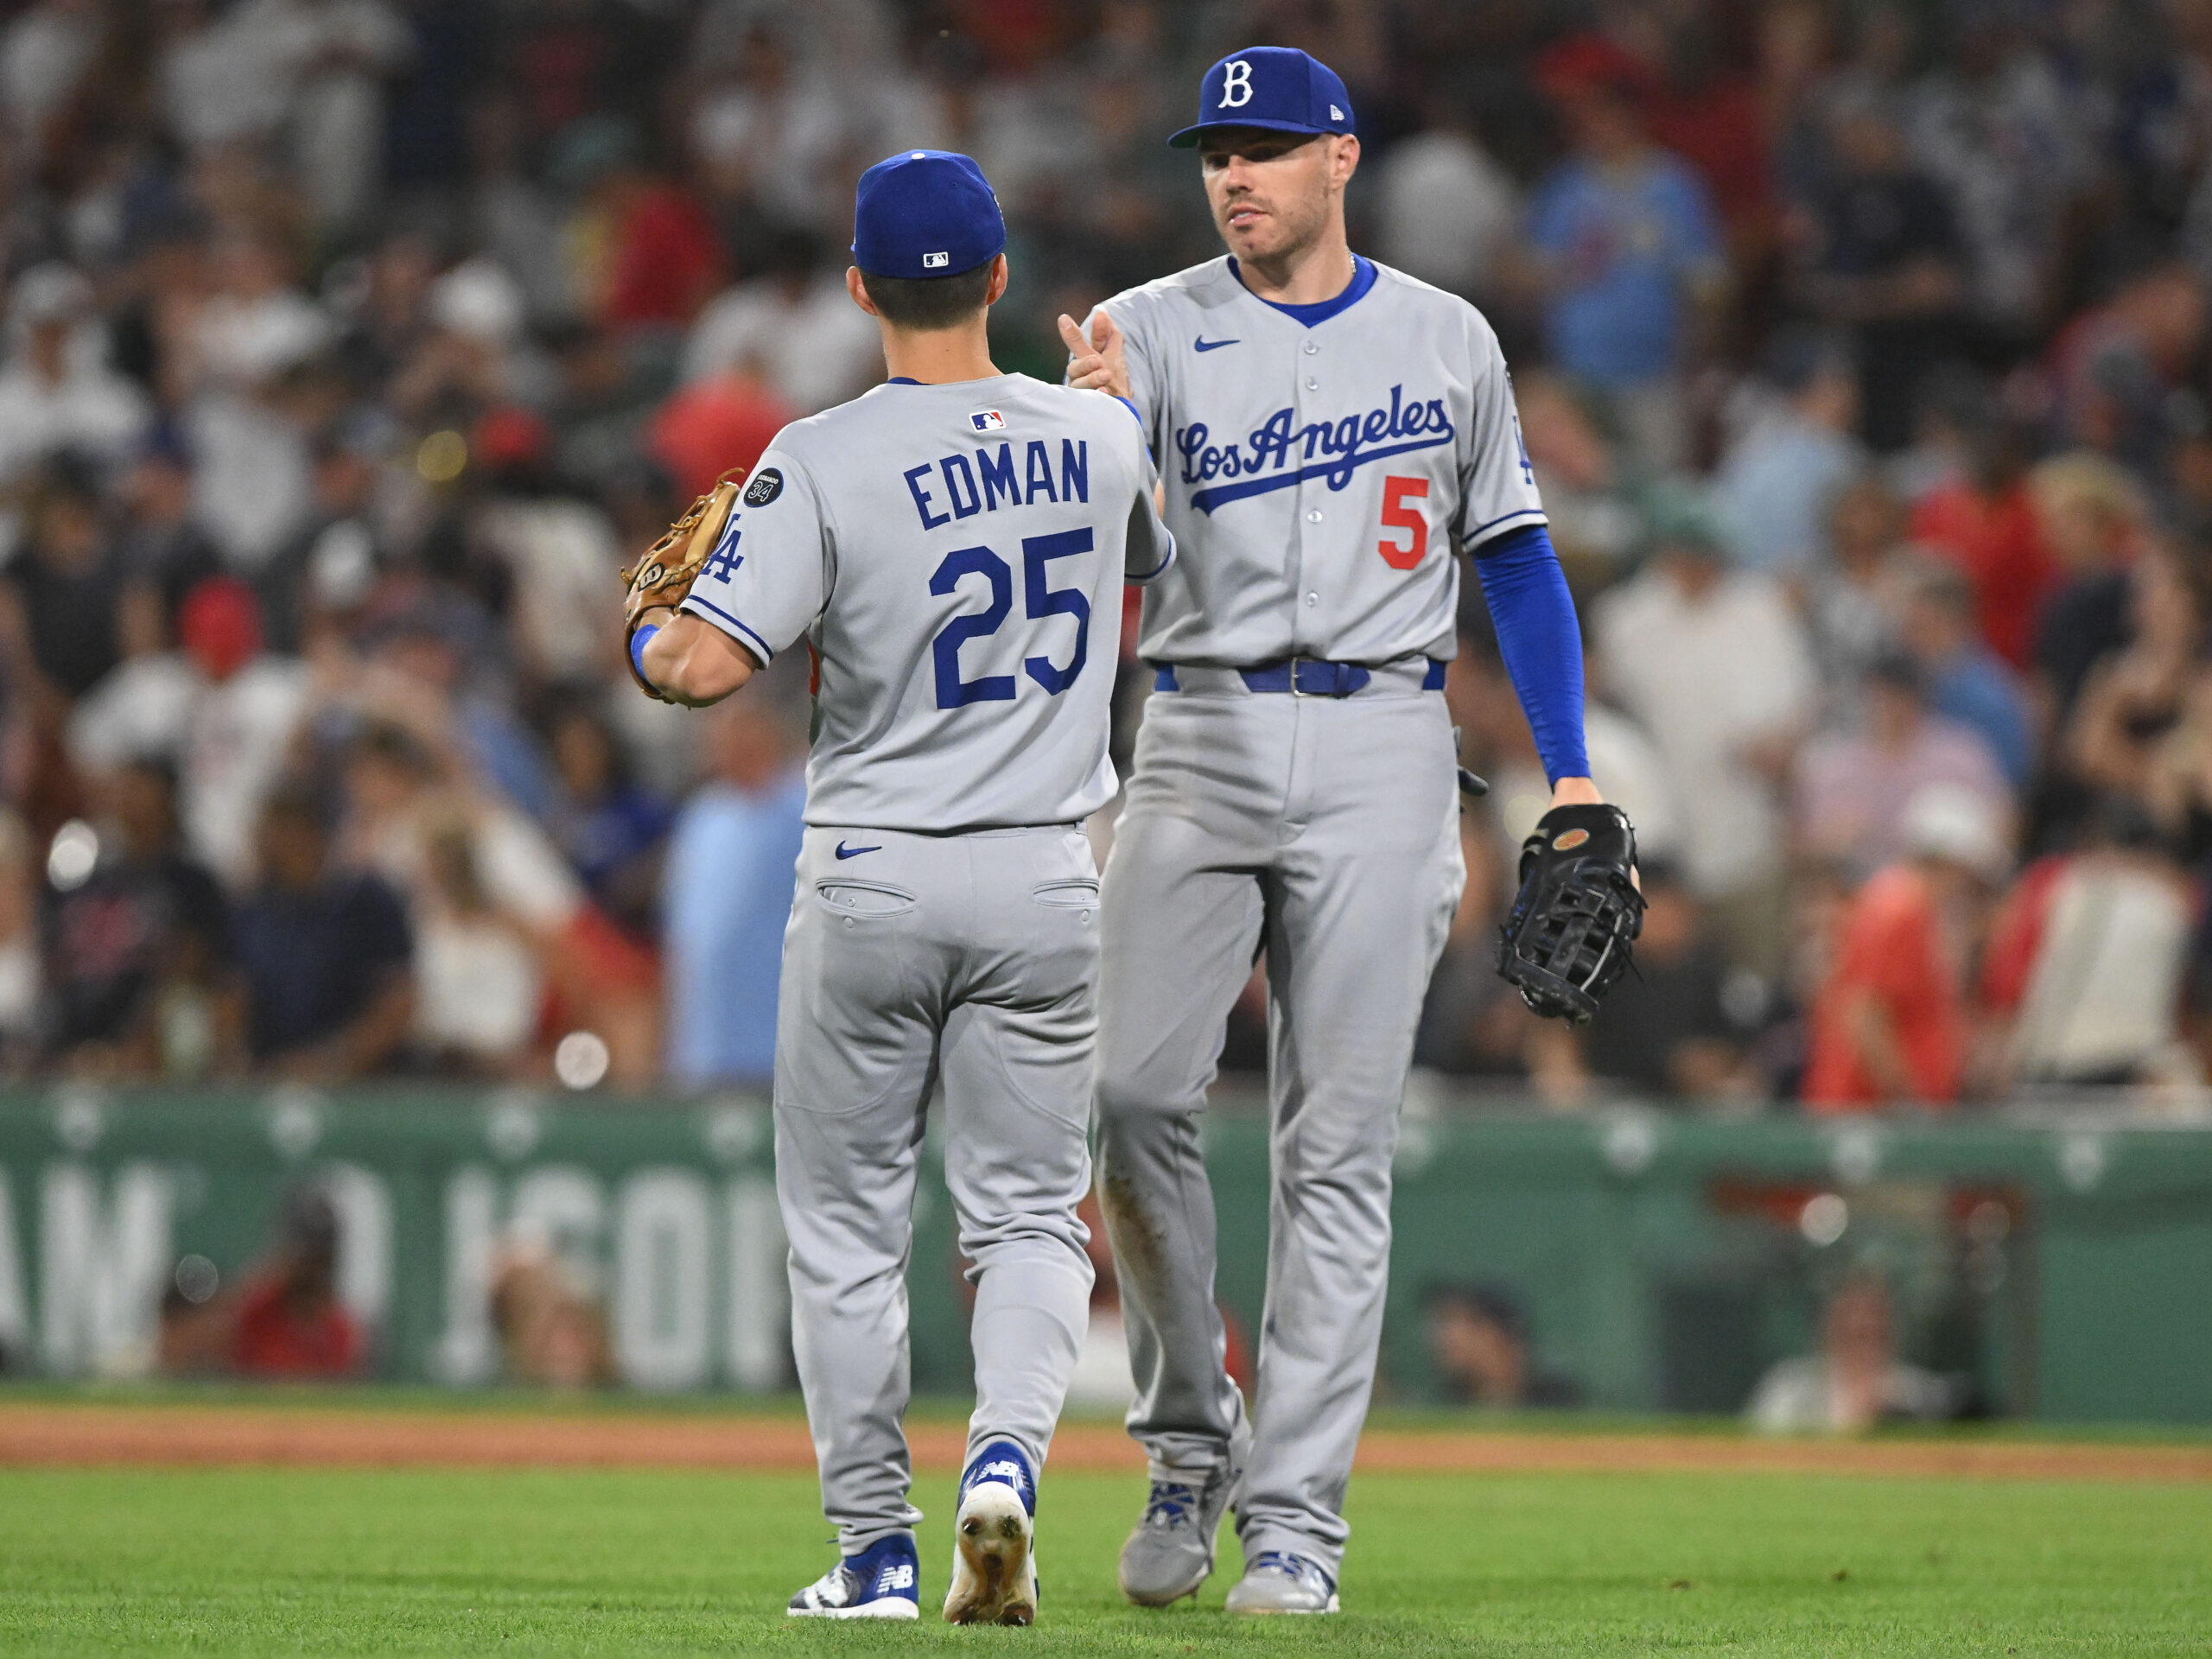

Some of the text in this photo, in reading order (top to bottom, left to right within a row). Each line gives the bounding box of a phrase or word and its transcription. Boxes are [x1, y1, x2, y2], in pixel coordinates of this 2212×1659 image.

[1217, 60, 1254, 109] B
[1176, 422, 1242, 485] Los
[1243, 383, 1453, 492] Angeles
[747, 480, 774, 502] 34
[903, 438, 1089, 531] EDMAN
[1378, 474, 1429, 570] 5
[929, 526, 1094, 710] 25
[876, 1564, 914, 1594] NB
